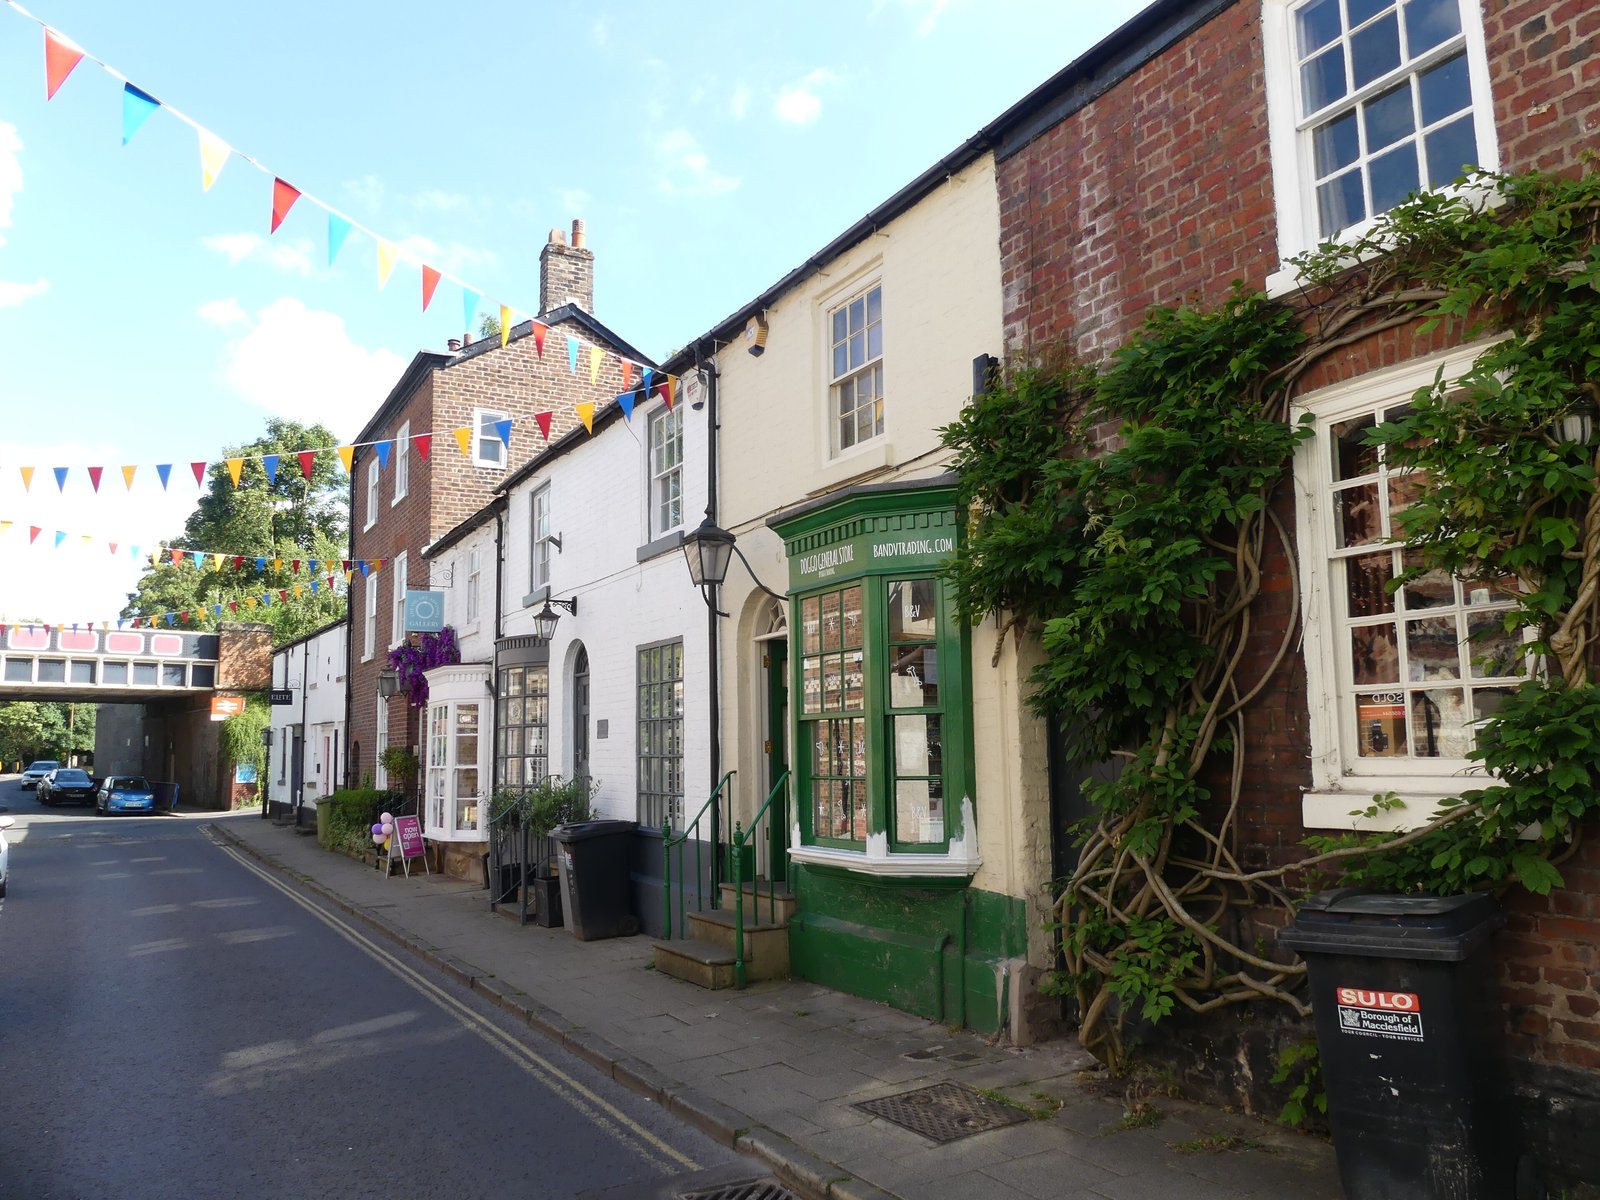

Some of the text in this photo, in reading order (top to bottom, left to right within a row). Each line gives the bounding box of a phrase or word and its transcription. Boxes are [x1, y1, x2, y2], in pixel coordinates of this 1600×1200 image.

[873, 538, 953, 558] BANDVTRADING.COM
[800, 555, 818, 575] DOGGO
[818, 548, 839, 570] GENERAL
[839, 544, 854, 565] STORE
[904, 604, 921, 618] B&V
[403, 832, 419, 841] open
[404, 826, 418, 834] now
[1340, 988, 1413, 1009] SULO
[1360, 1010, 1412, 1025] Borough of
[1355, 1030, 1378, 1038] COUNCIL
[1362, 1019, 1418, 1034] Macclesfield
